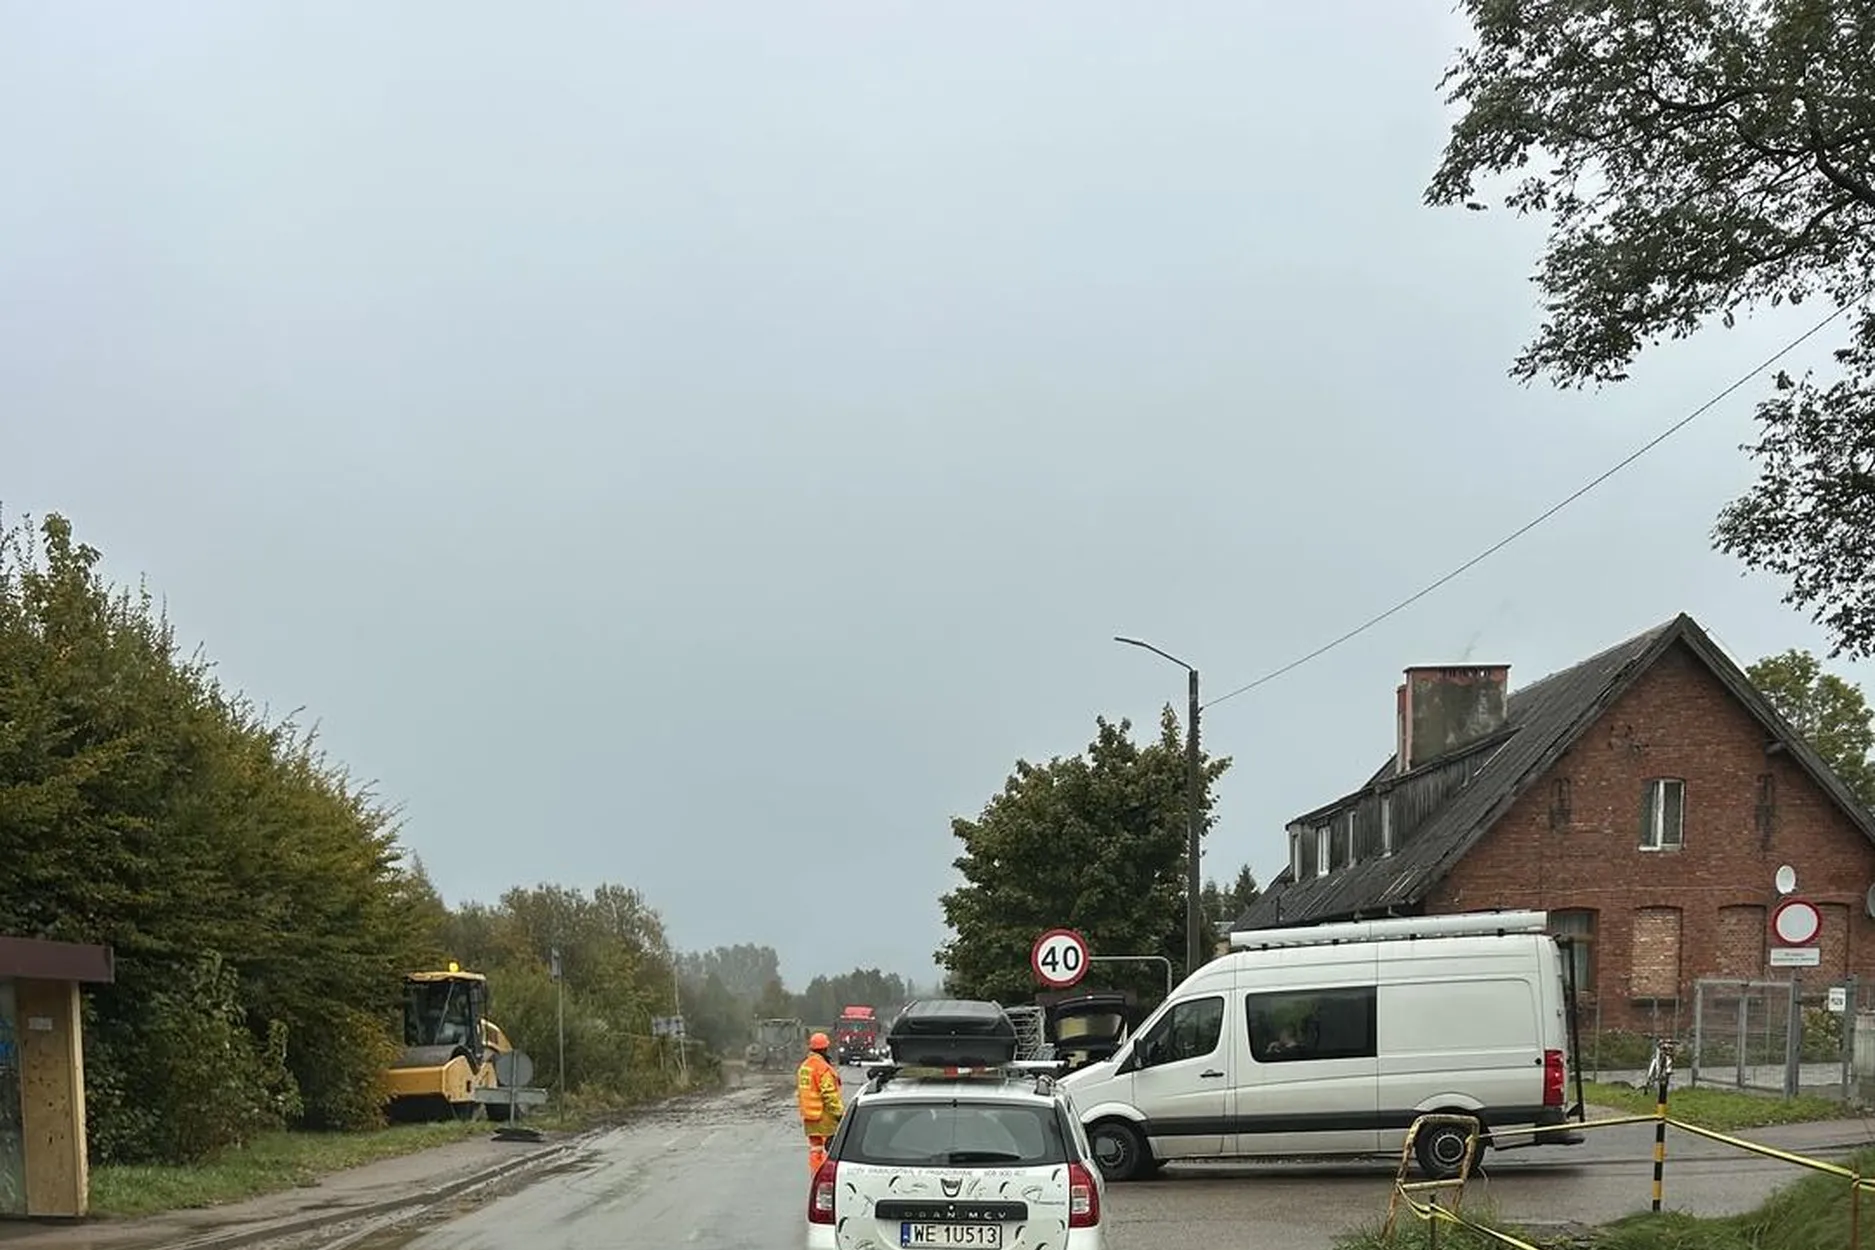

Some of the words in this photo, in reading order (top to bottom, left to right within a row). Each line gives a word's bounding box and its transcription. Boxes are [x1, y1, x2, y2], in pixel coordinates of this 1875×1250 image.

[1041, 946, 1080, 972] 40
[968, 1211, 1006, 1219] MCV
[914, 1225, 935, 1243] WE
[943, 1226, 997, 1244] 1U513
